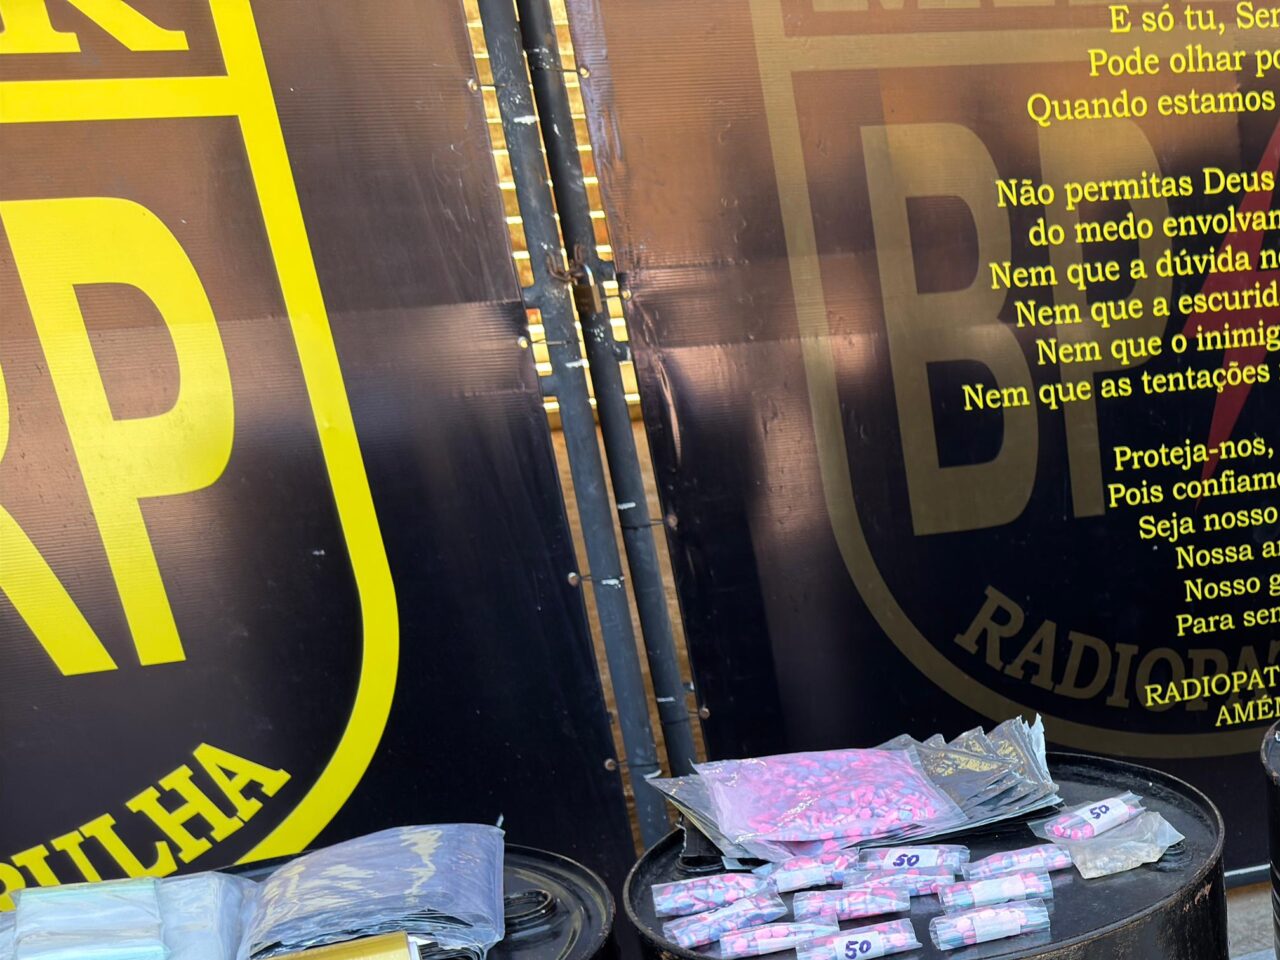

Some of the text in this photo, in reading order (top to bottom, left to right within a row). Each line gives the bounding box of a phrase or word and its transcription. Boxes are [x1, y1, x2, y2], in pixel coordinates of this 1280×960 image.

[1141, 3, 1175, 33] só
[1183, 7, 1226, 36] tu,
[1087, 46, 1160, 77] Pode
[1169, 43, 1247, 74] olhar
[1026, 89, 1148, 128] Quando
[1157, 90, 1276, 116] estamos
[996, 179, 1055, 208] Não
[1064, 170, 1193, 211] permitas
[1203, 167, 1275, 195] Deus
[1029, 218, 1065, 247] do
[1074, 212, 1154, 244] medo
[989, 261, 1058, 290] Nem
[1067, 261, 1120, 291] que
[1130, 259, 1148, 280] a
[1155, 245, 1252, 278] dúvida
[1015, 300, 1083, 328] Nem
[1091, 299, 1143, 329] que
[1152, 297, 1170, 317] a
[1037, 338, 1103, 365] Nem
[1110, 336, 1162, 366] que
[1171, 335, 1187, 353] o
[963, 384, 1030, 411] Nem
[1039, 381, 1091, 410] que
[1101, 378, 1132, 398] as
[1142, 361, 1271, 394] tentações
[1113, 438, 1274, 471] Proteja-nos,
[1108, 483, 1164, 508] Pois
[1139, 515, 1195, 543] Seja
[1204, 507, 1278, 531] nosso
[1176, 545, 1253, 569] Nossa
[1184, 578, 1261, 602] Nosso
[1176, 614, 1234, 637] Para
[892, 853, 920, 867] 50
[844, 939, 872, 960] 50
